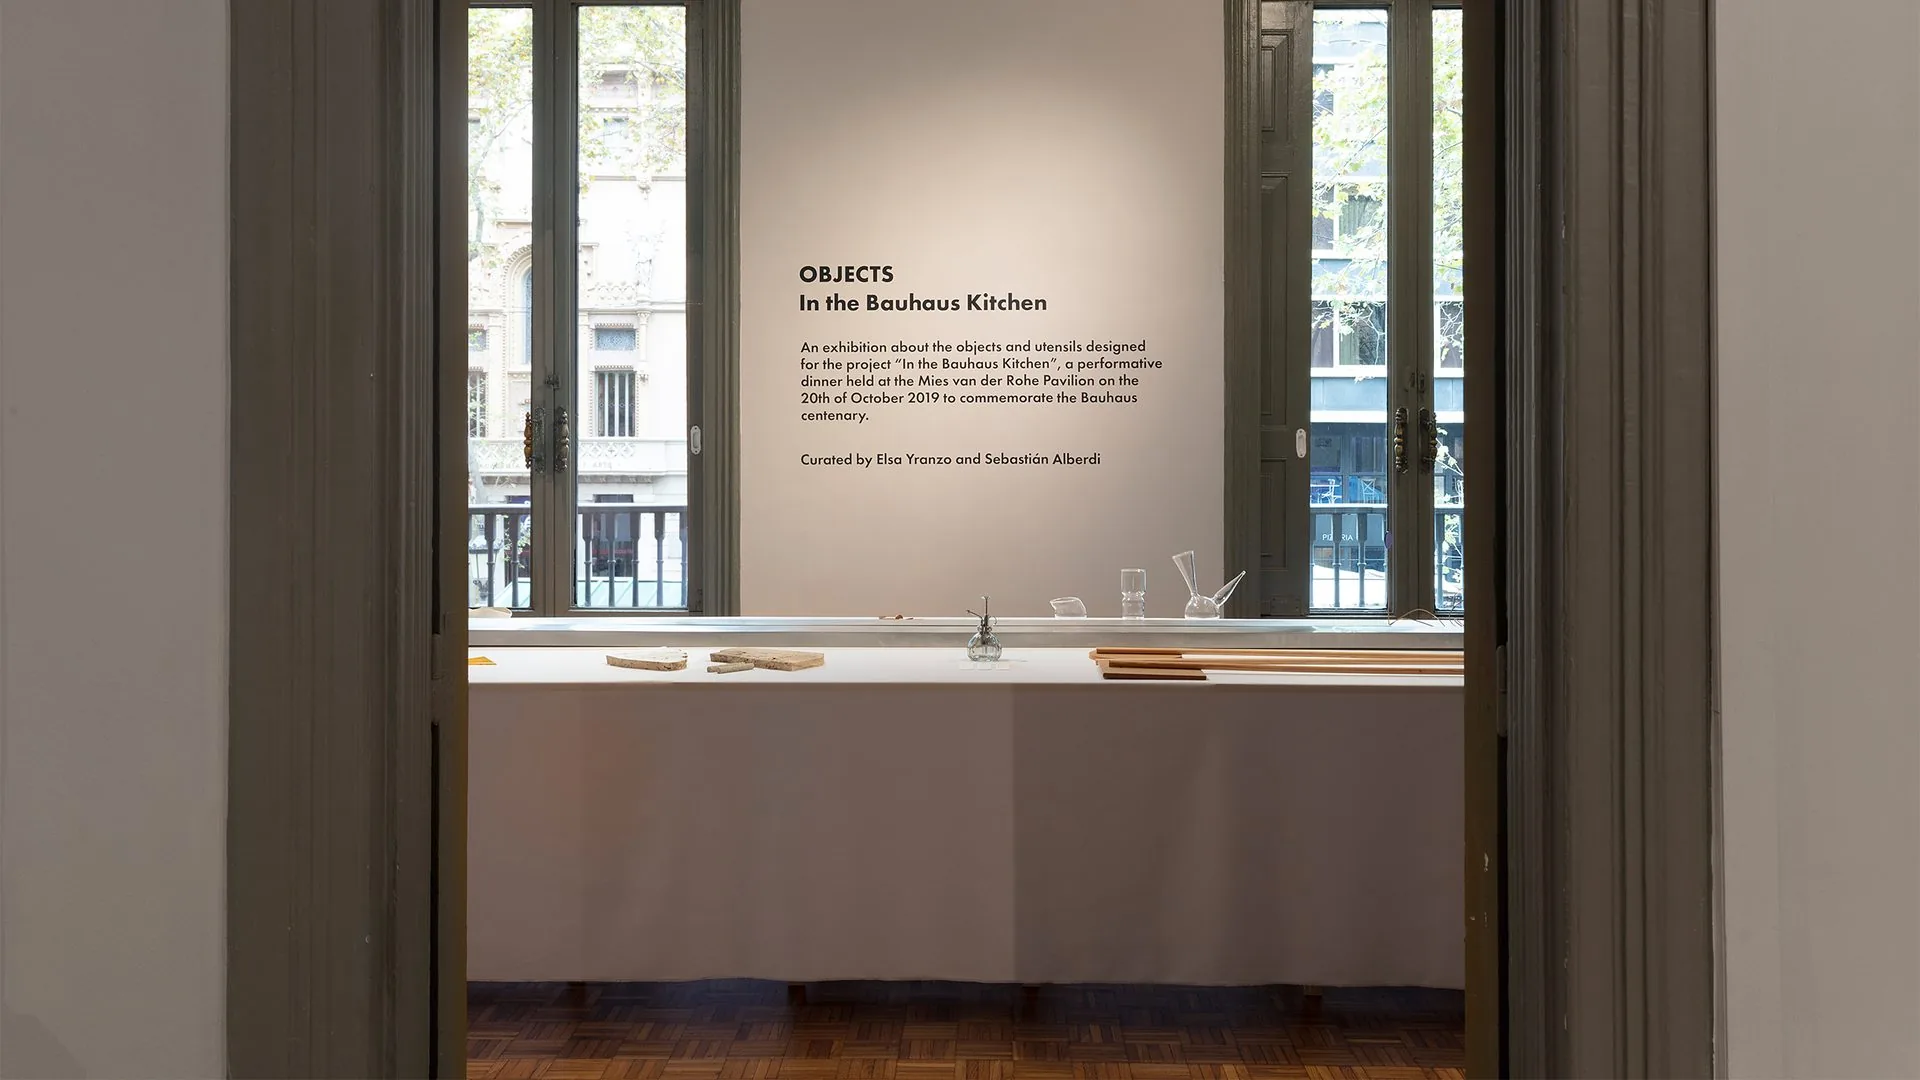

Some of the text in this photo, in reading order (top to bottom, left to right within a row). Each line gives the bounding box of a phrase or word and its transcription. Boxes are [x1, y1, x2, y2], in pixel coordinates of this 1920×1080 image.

[799, 265, 894, 283] OBJECTS
[799, 292, 1047, 312] In the Bauhaus Kitchen
[800, 339, 1146, 356] An exhibition about the objects and utensils designed
[800, 357, 820, 370] for
[822, 357, 843, 370] the
[846, 357, 892, 373] project
[917, 356, 938, 370] the
[942, 356, 999, 370] Bauhaus
[1065, 361, 1073, 370] a
[1077, 356, 1163, 373] performative
[800, 373, 1139, 387] dinner held at the Mies van der Rohe Pavilion on the
[800, 390, 1138, 404] 20th of October 2019 to commemorate the Bauhaus
[800, 410, 869, 424] centenary.
[800, 452, 1101, 469] Curated by Elsa Yranzo and Sebastián Alberdi
